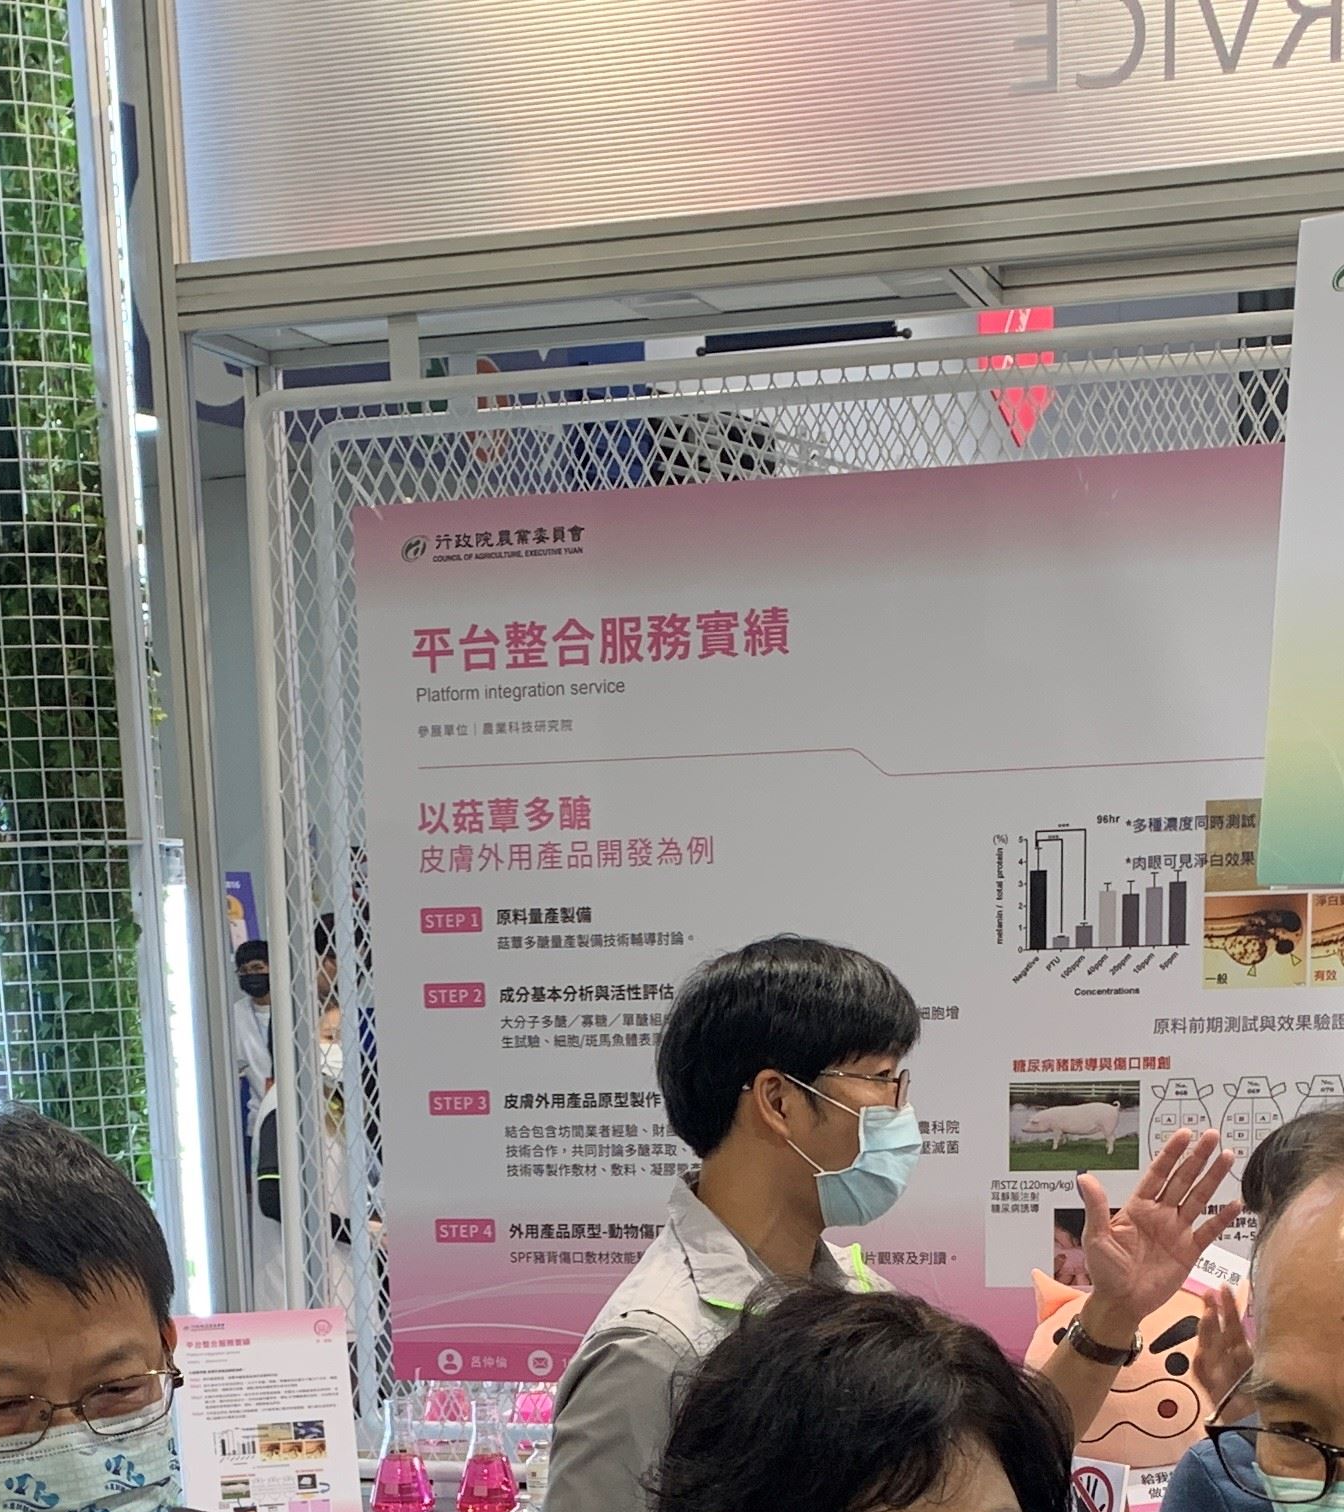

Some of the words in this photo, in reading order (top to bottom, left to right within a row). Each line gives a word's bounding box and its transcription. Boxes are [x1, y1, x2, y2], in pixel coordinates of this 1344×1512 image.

[434, 524, 585, 551] 行政院農業委員會
[432, 554, 463, 563] COUNCIL
[411, 605, 791, 674] 平台整合服務實績
[416, 685, 480, 704] Platform
[484, 681, 565, 703] integration
[569, 678, 626, 695] service
[418, 796, 592, 836] 以菇蕈多醣
[419, 836, 715, 874] 皮膚外用產品開發為例
[424, 914, 468, 929] STEP
[470, 913, 480, 928] 1
[496, 907, 593, 926] 原料量產製備
[1205, 973, 1228, 985] 一般
[1314, 969, 1337, 982] 有效
[428, 990, 471, 1005] STEP
[473, 989, 484, 1003] 2
[499, 983, 675, 1003] 成分基本分析與活性評估
[1074, 987, 1140, 997] Concentrations
[433, 1097, 474, 1112] STEP
[477, 1096, 488, 1110] 3
[1019, 1180, 1074, 1192] (120mg/kg)
[439, 1224, 480, 1239] STEP
[483, 1224, 494, 1238] 4
